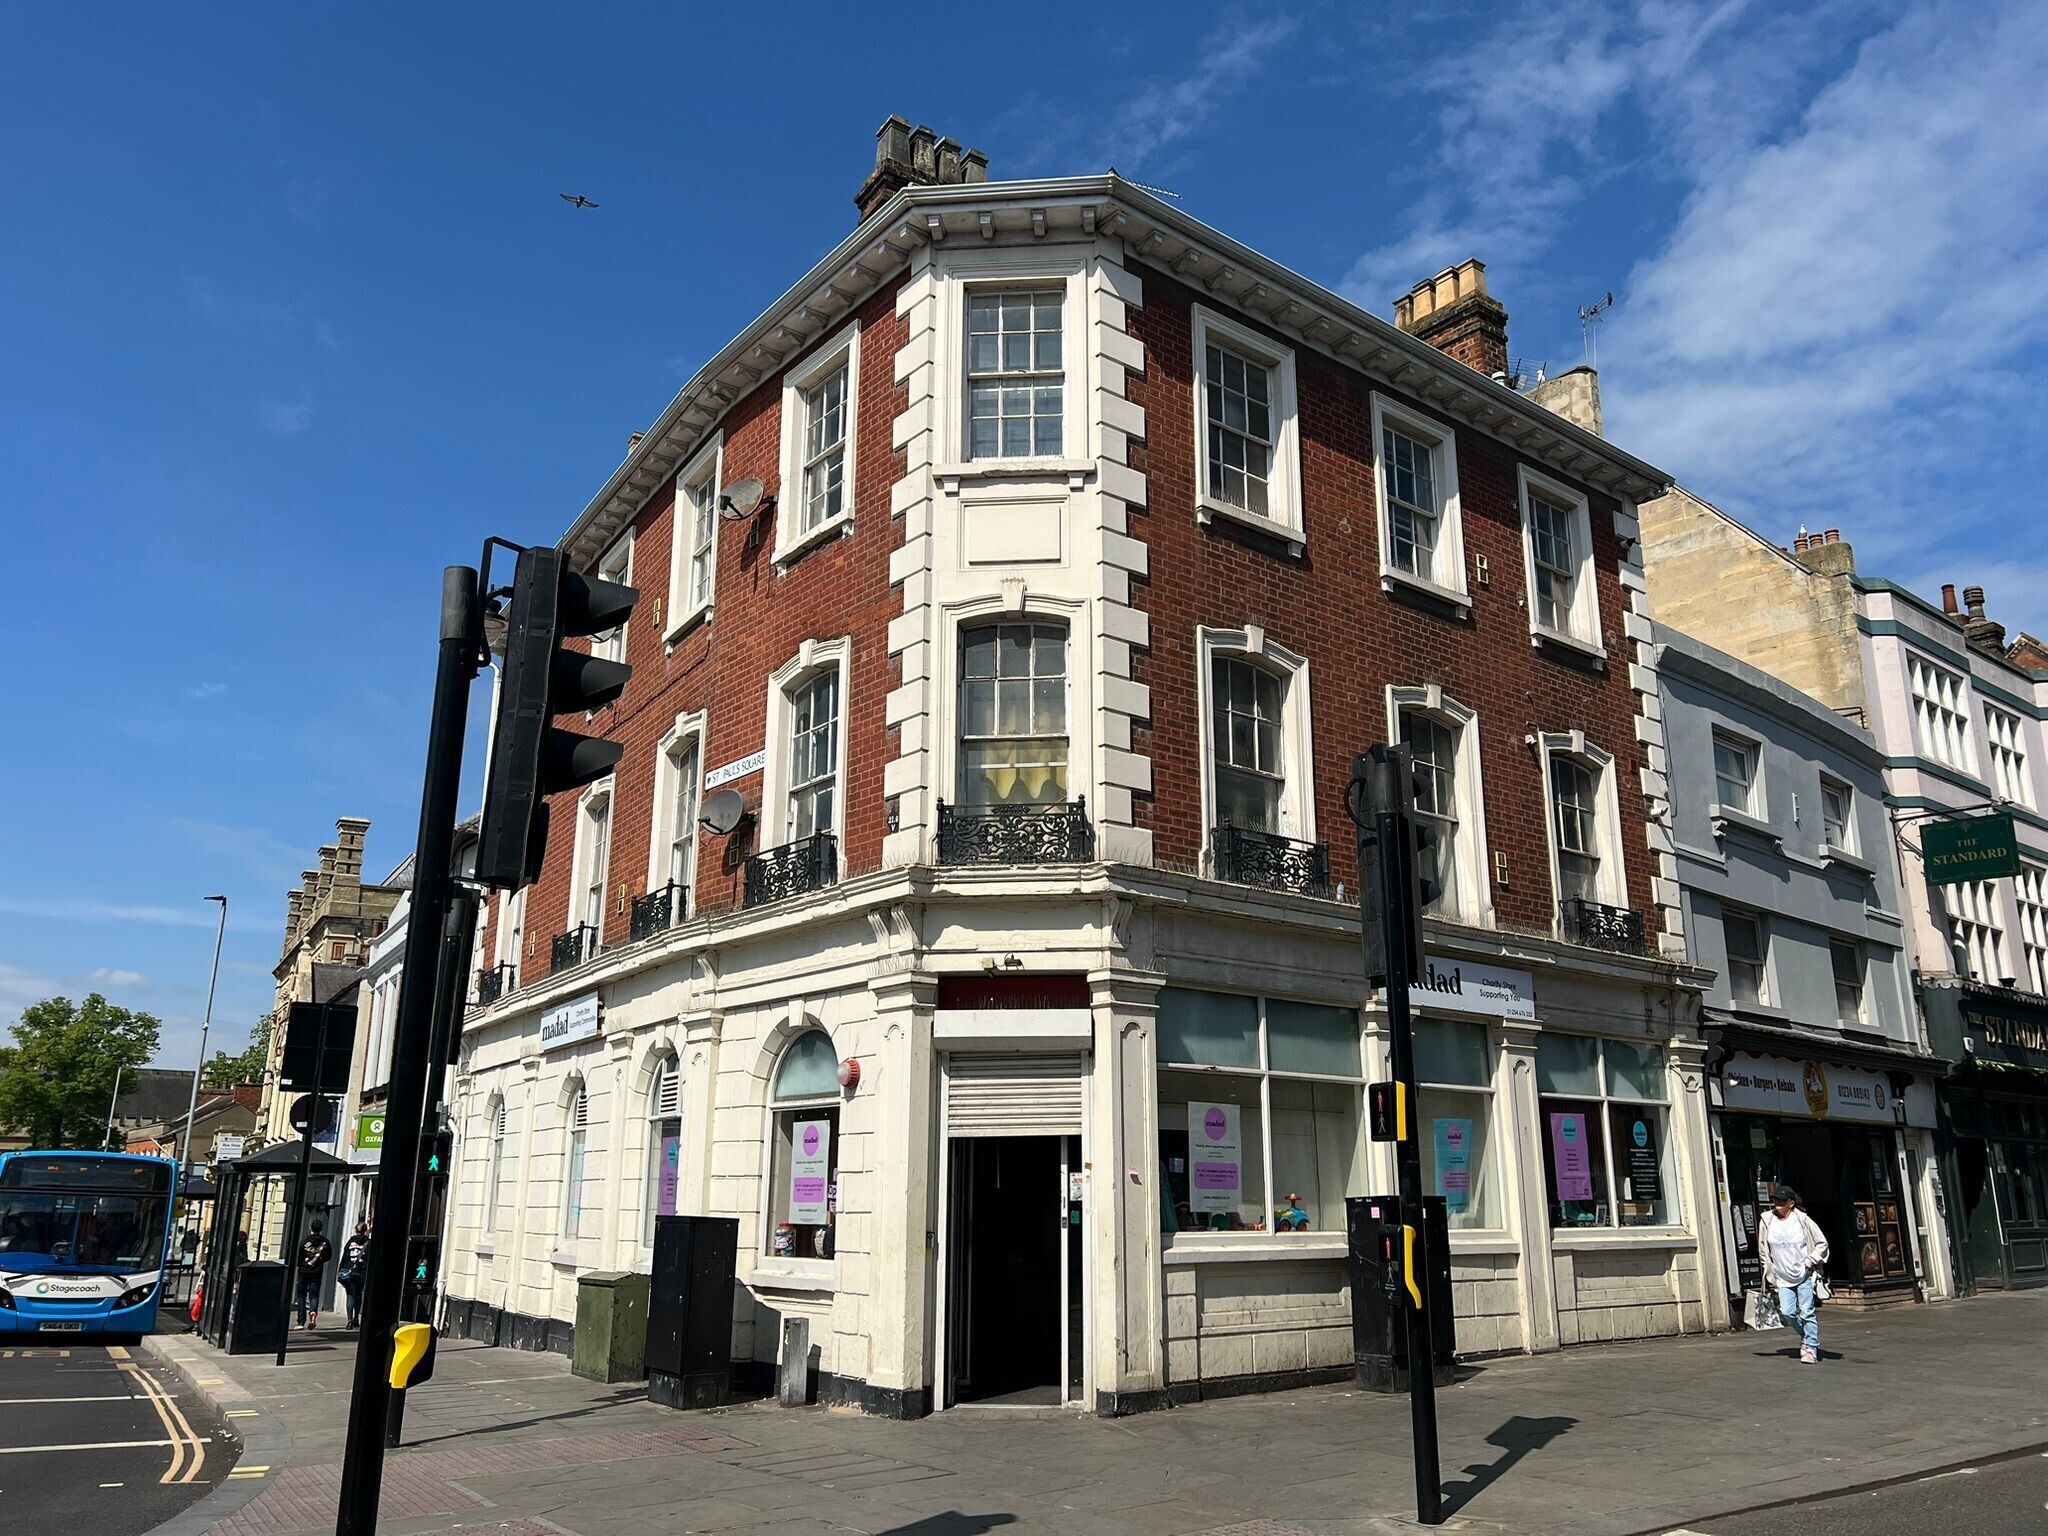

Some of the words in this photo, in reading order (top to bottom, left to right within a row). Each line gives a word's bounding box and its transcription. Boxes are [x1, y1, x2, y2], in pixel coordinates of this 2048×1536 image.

[742, 753, 766, 771] SQUARE
[1957, 838, 1980, 847] THE
[1933, 847, 2007, 866] STANDARD
[1408, 963, 1463, 996] dad
[1480, 988, 1509, 1002] Supporting
[542, 1011, 569, 1041] madad
[1753, 1075, 1774, 1091] Burgers
[1777, 1079, 1796, 1092] Kebabs
[50, 1284, 101, 1293] Stagecoach
